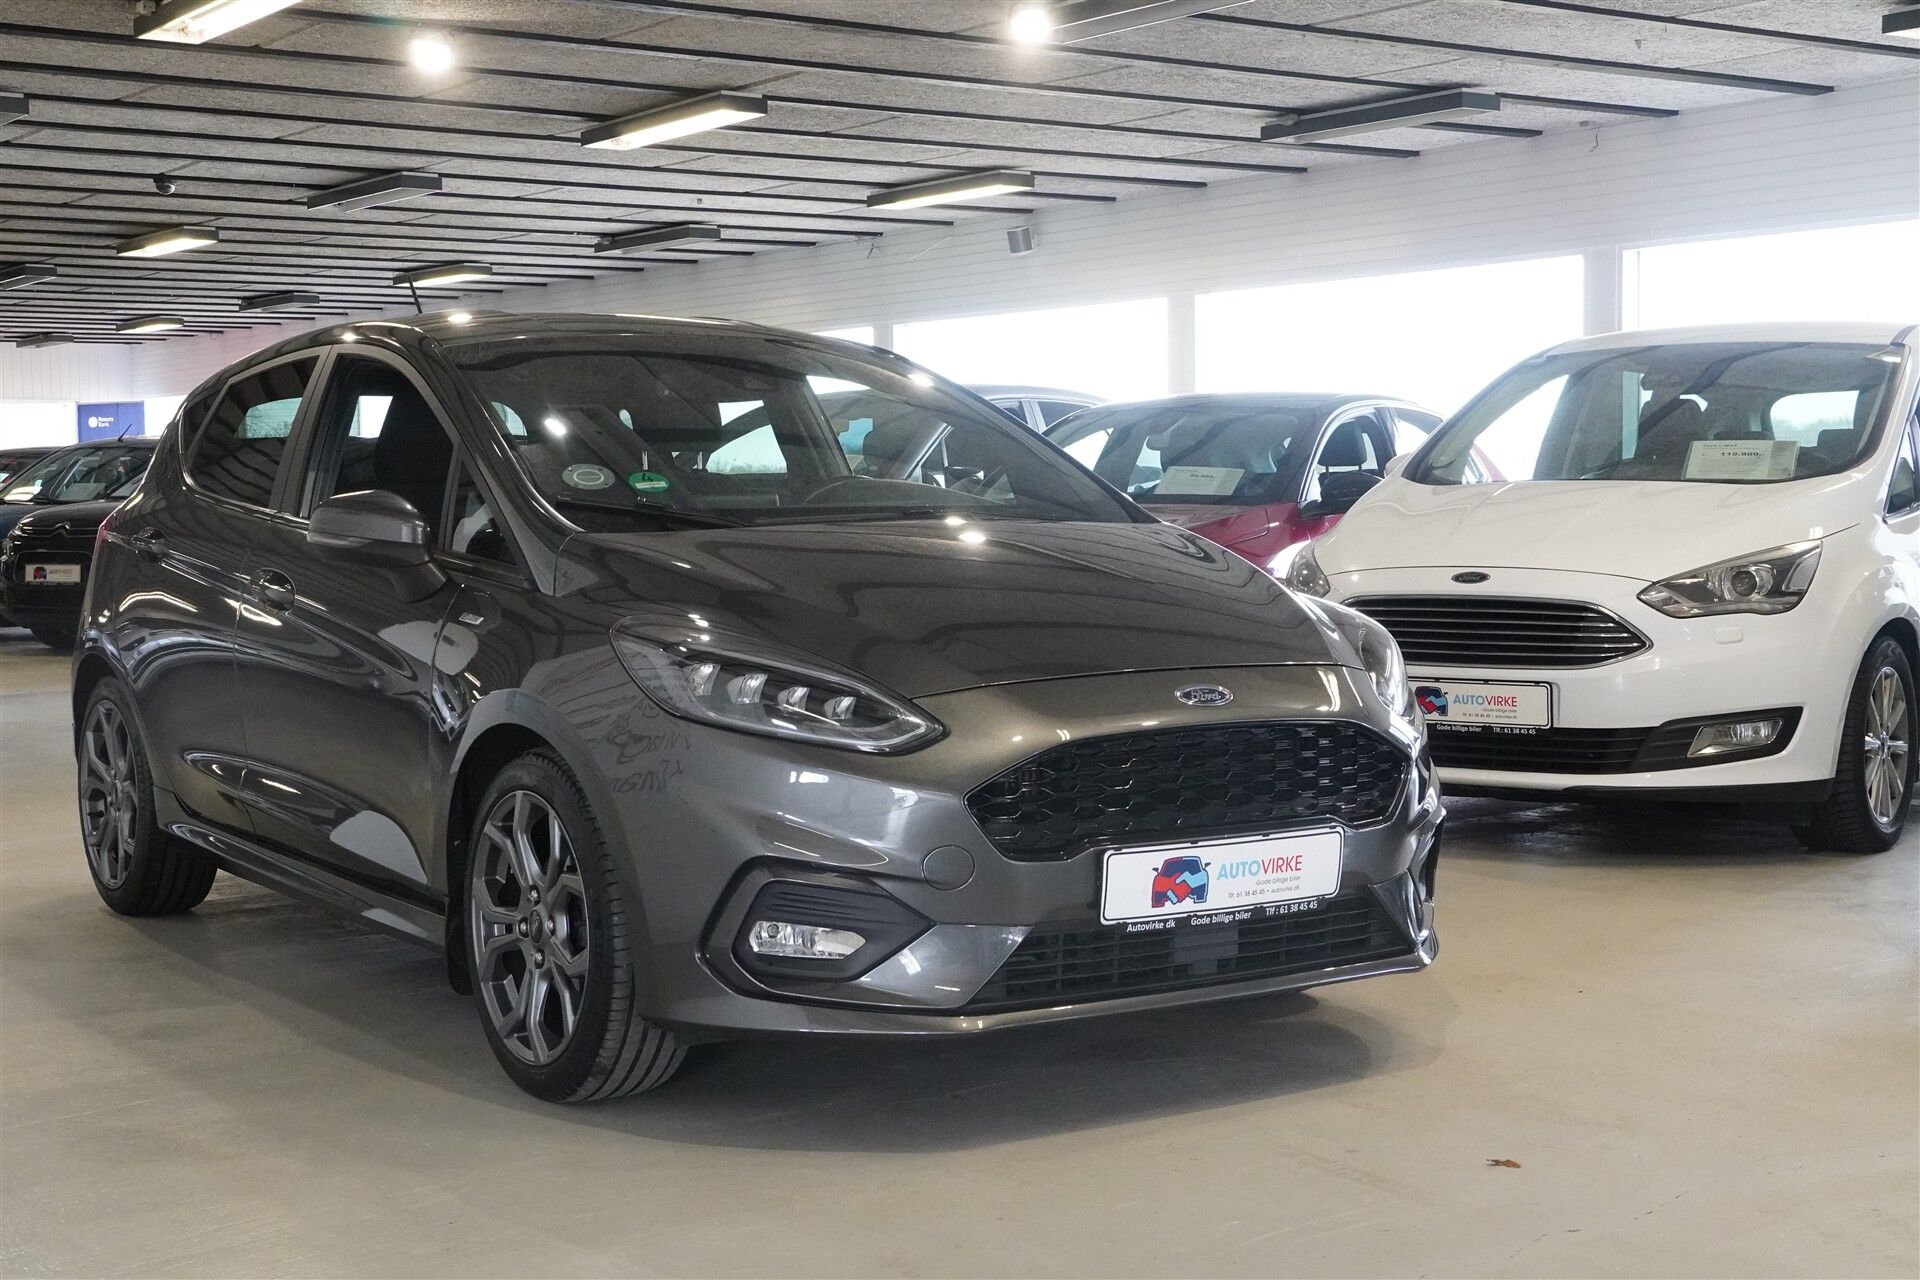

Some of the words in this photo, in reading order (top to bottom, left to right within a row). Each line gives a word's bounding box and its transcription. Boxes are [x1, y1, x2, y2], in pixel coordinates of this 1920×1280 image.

[1191, 690, 1222, 701] Ford
[1453, 694, 1518, 708] AUTOVIRKE
[1216, 855, 1303, 880] AUTOVIRKE
[1190, 917, 1211, 926] Gode
[1212, 914, 1234, 924] billige
[1235, 911, 1252, 920] biler
[1280, 905, 1288, 914] 61
[1290, 904, 1298, 912] 38
[1299, 902, 1308, 910] 45
[1309, 901, 1318, 909] 45
